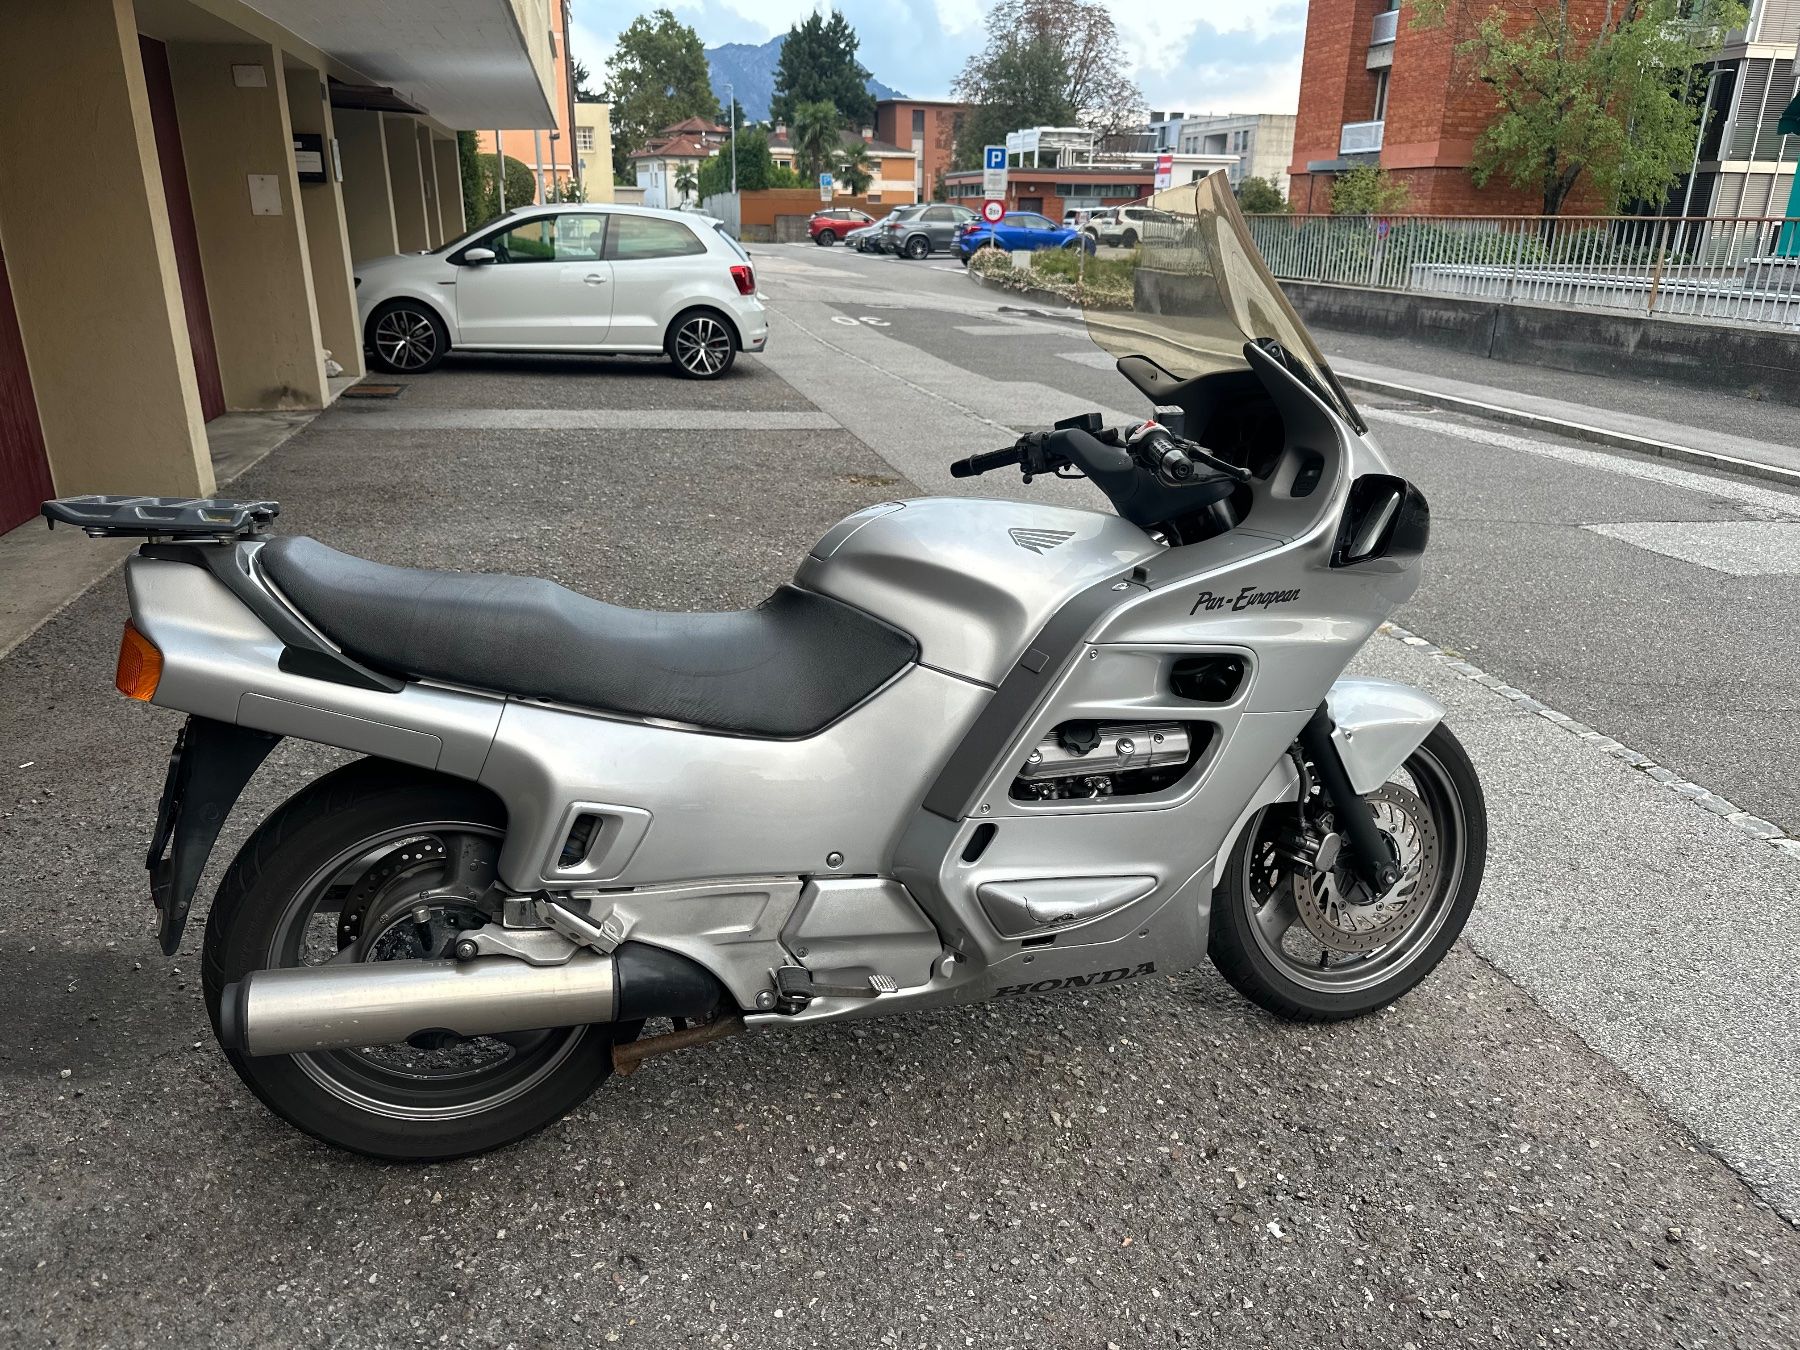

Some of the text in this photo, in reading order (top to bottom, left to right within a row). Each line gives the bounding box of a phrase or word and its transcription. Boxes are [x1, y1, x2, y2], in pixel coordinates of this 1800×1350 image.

[991, 151, 1002, 168] P
[1190, 586, 1301, 616] Pan-European
[991, 961, 1157, 998] HONDA
